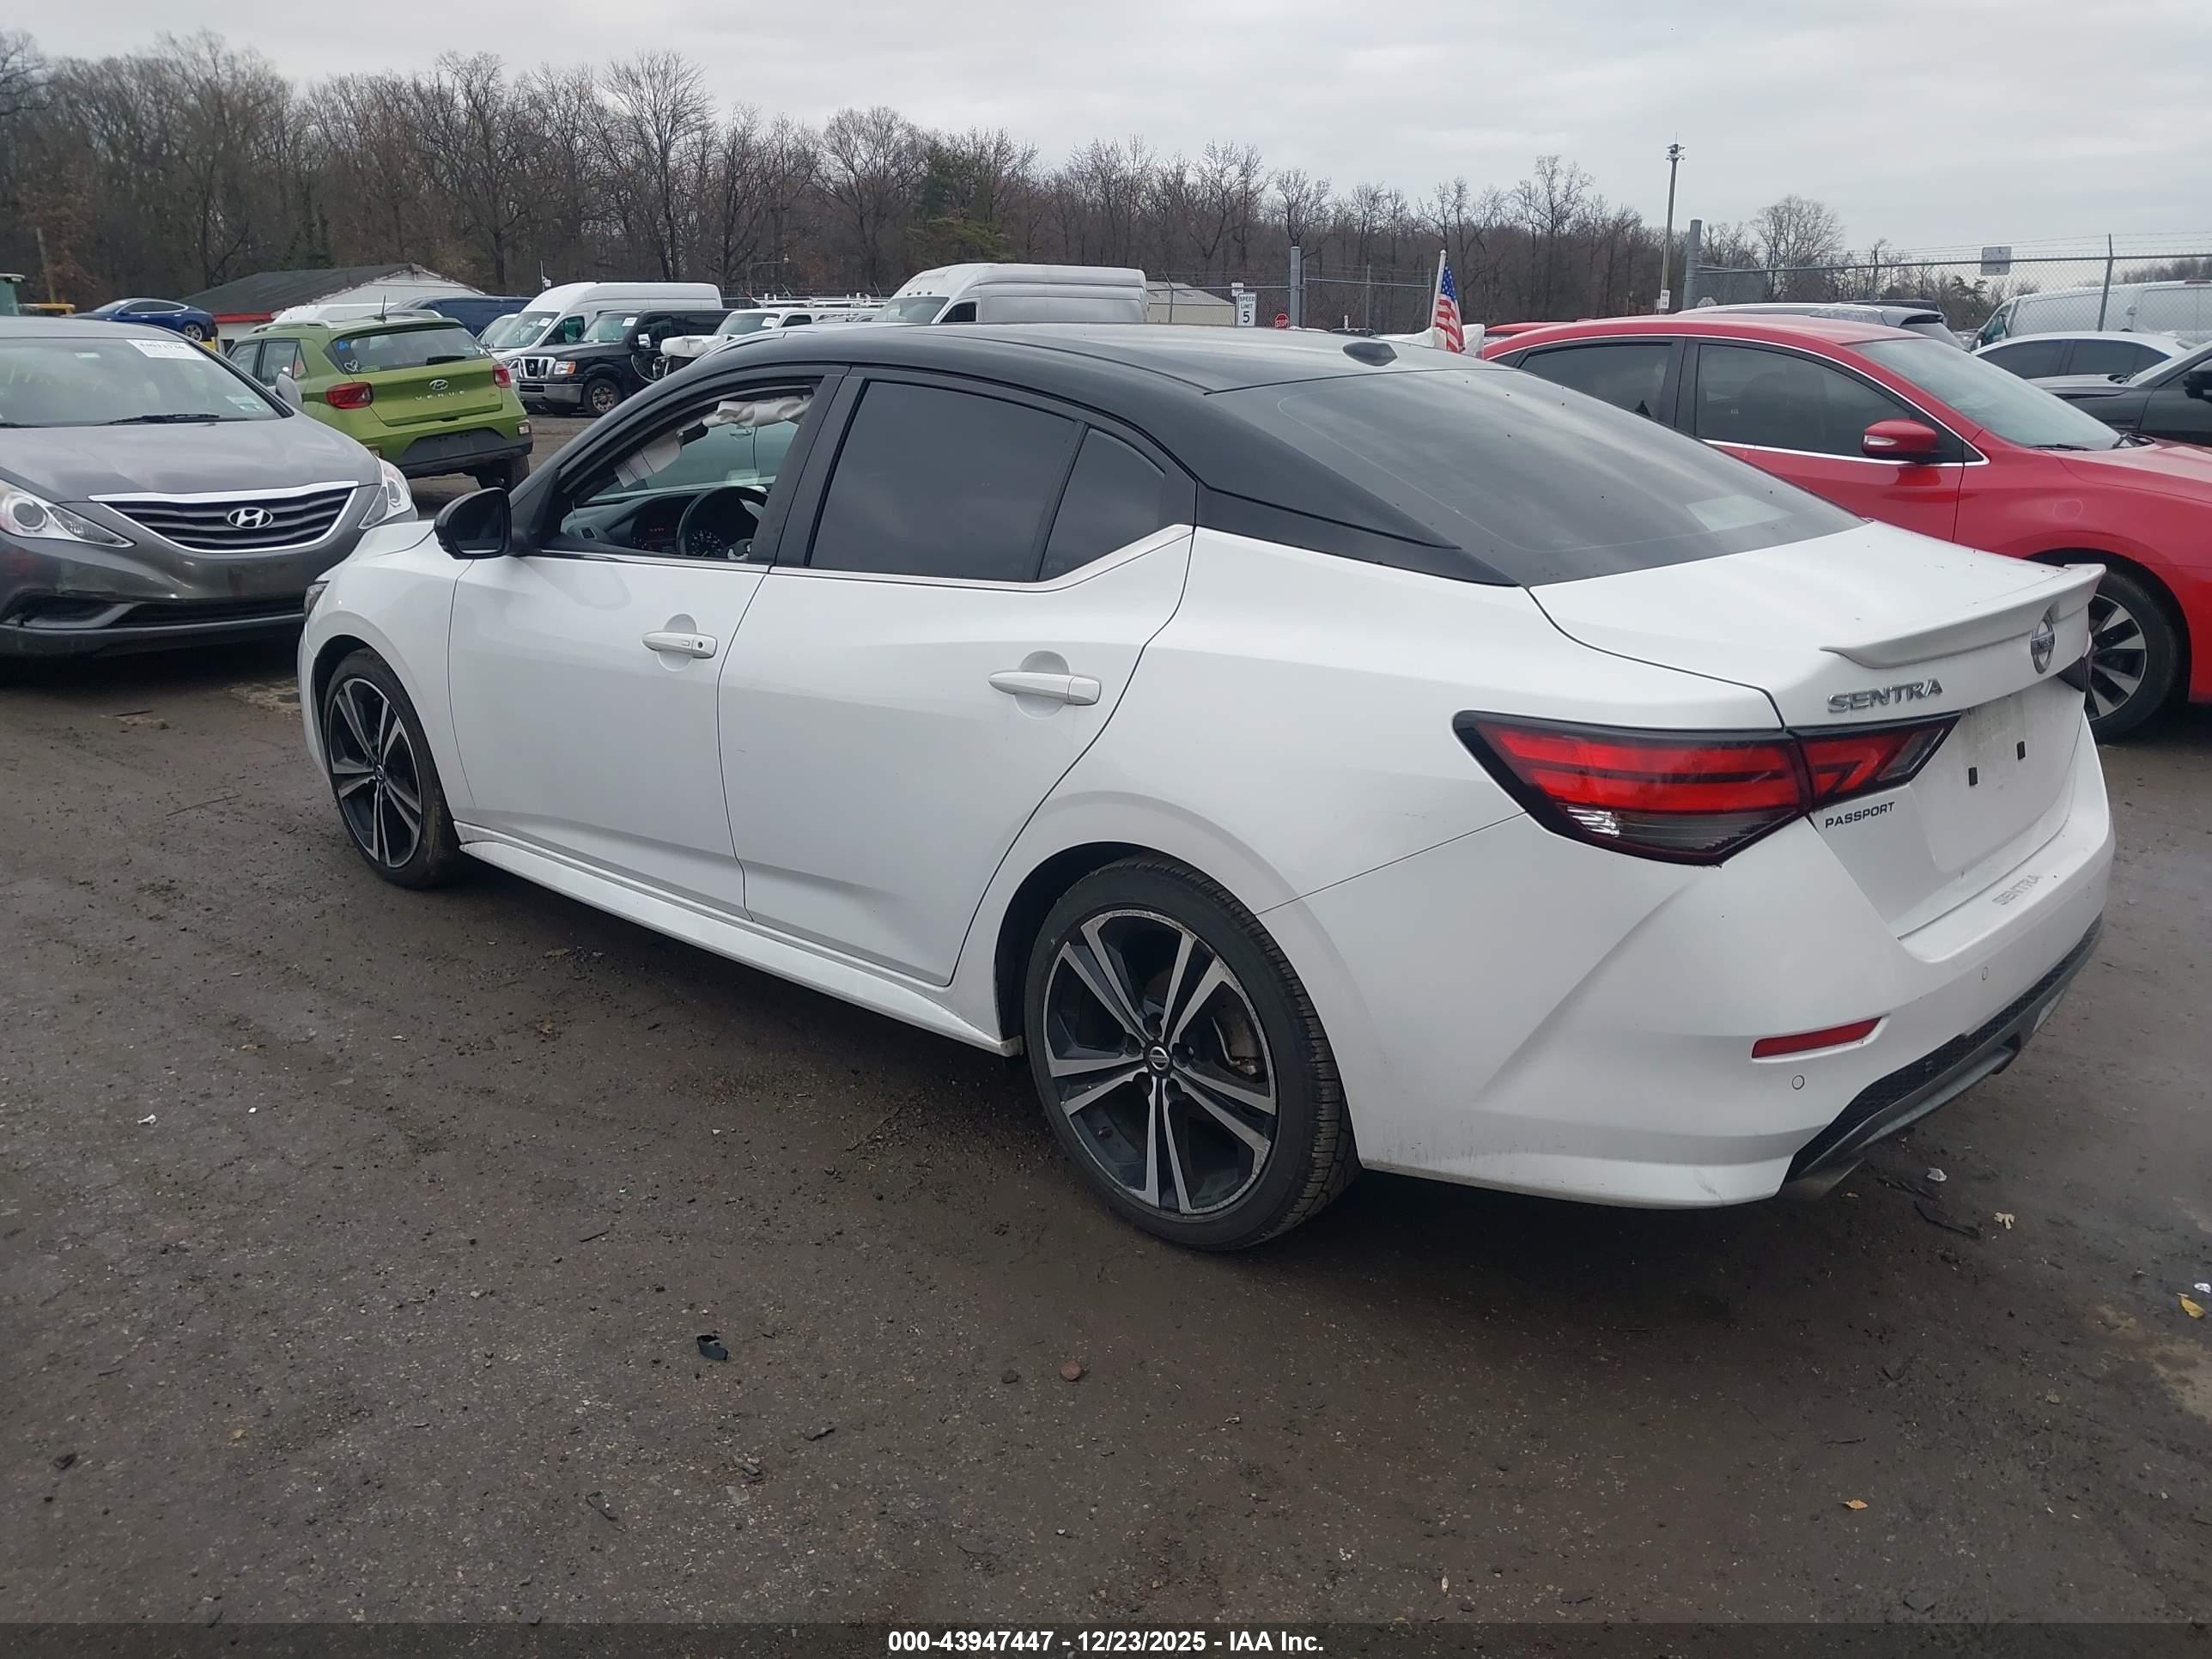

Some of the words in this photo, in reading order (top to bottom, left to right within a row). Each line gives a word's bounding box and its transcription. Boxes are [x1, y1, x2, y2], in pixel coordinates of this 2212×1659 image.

[1243, 310, 1250, 324] 5
[1275, 319, 1288, 328] STOP
[415, 390, 465, 401] VENUE
[1826, 678, 1943, 714] SENTRA
[1825, 801, 1896, 830] PASSPORT
[1992, 874, 2042, 906] SENTRA
